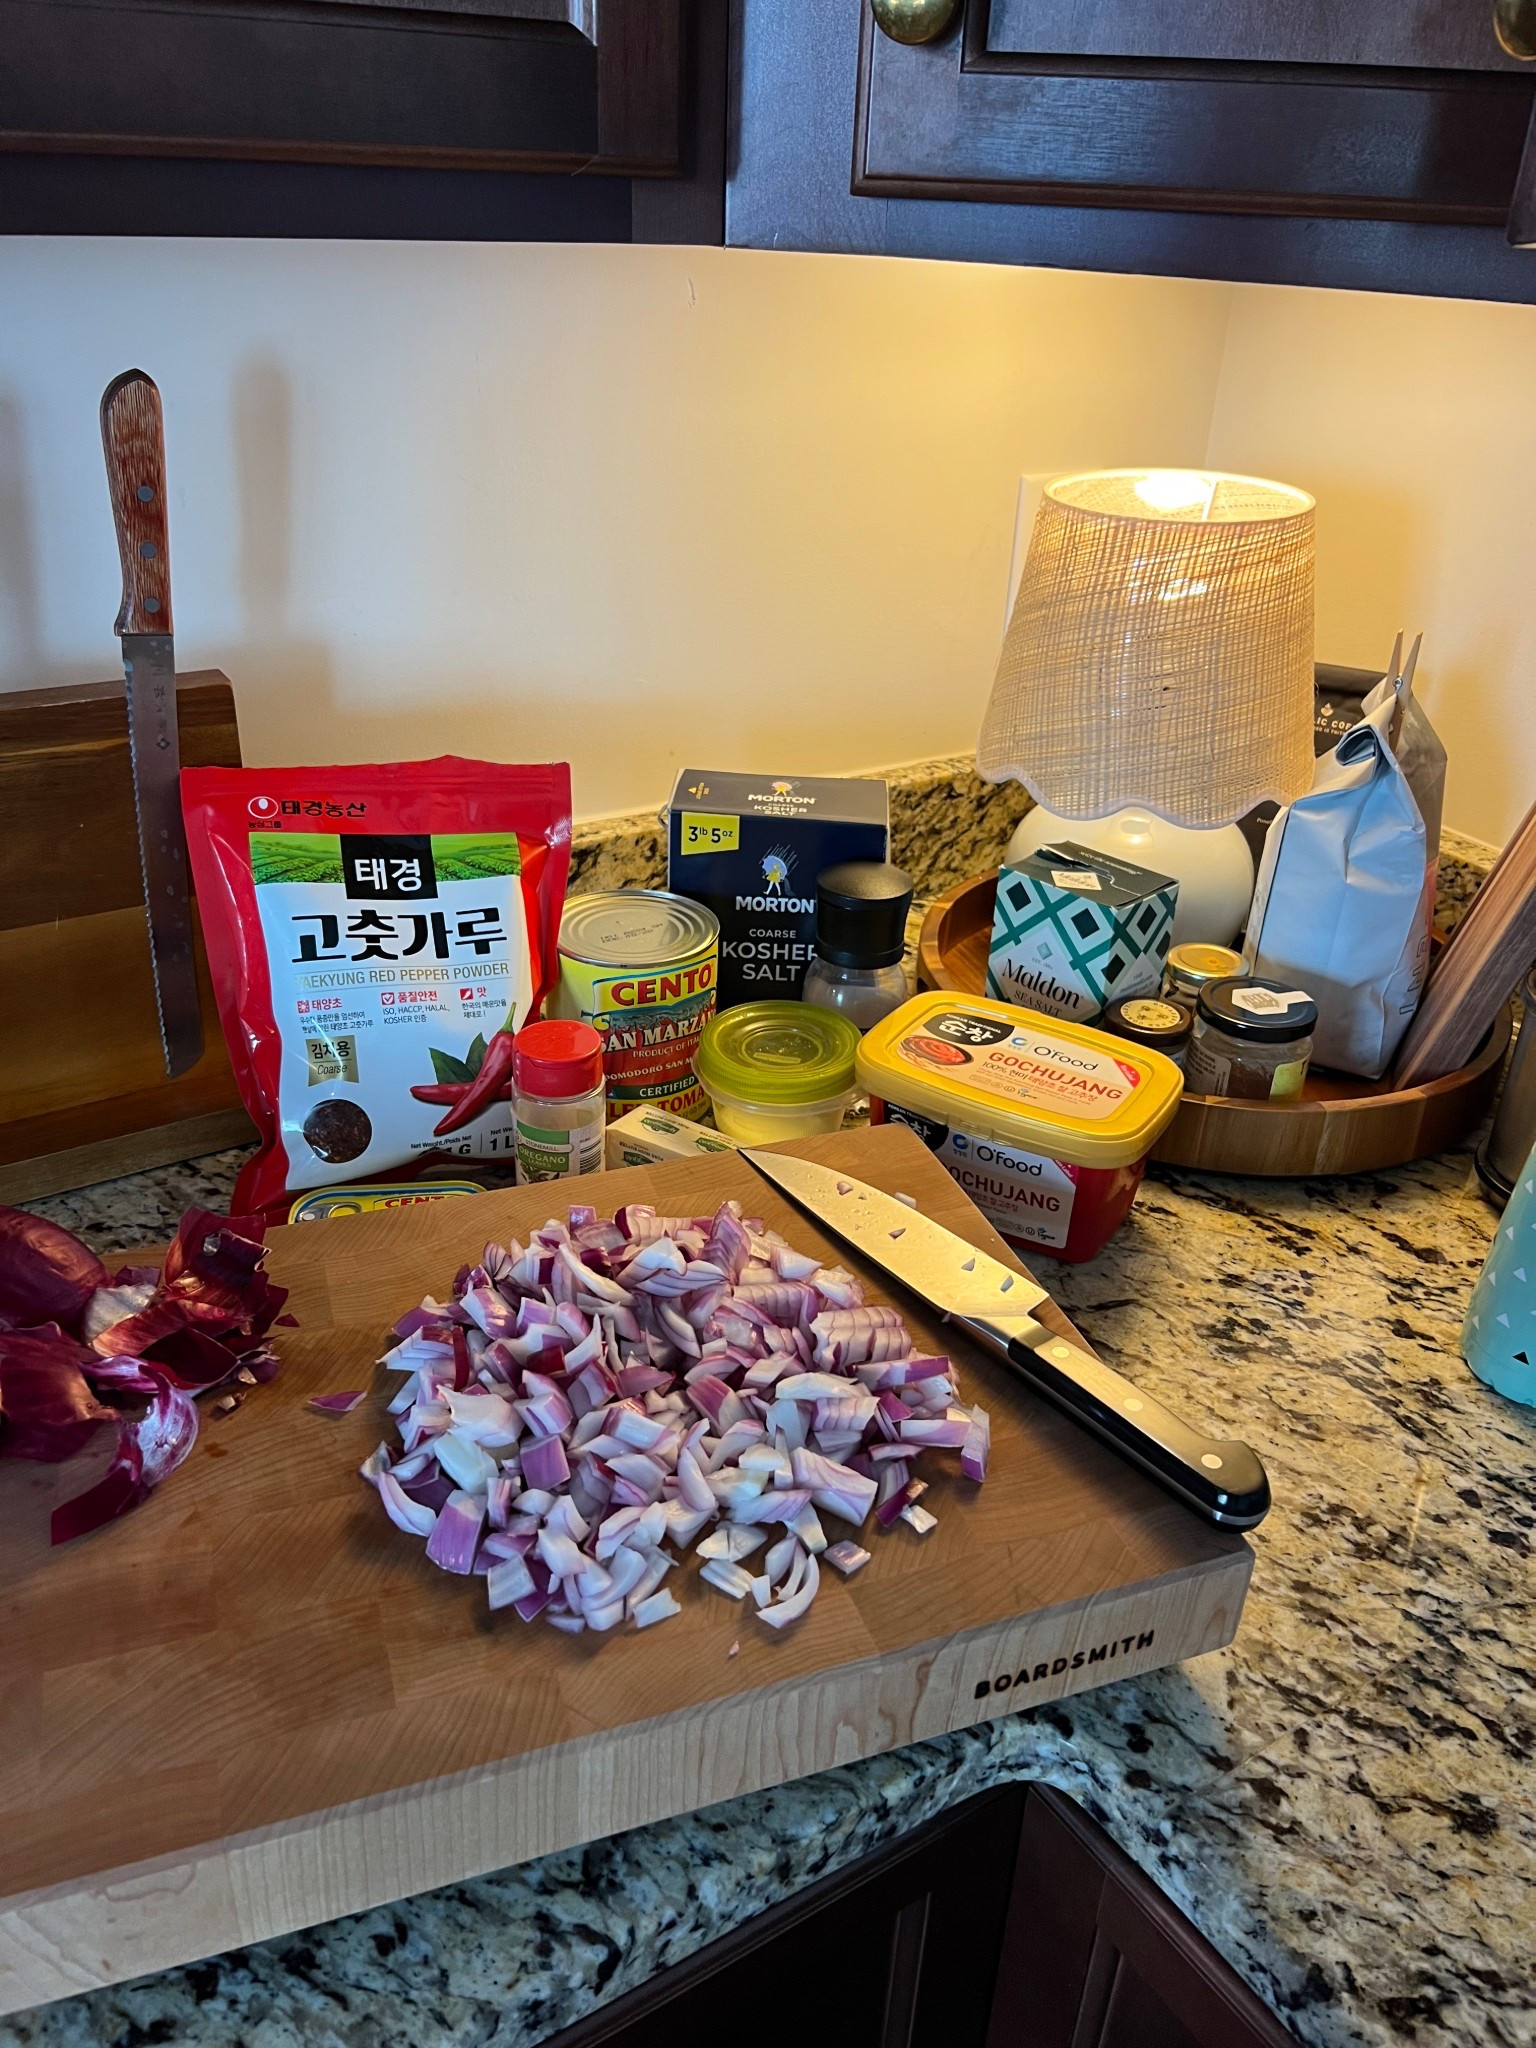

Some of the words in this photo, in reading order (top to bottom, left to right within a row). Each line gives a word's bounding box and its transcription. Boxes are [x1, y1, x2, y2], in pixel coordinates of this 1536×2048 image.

[747, 794, 816, 804] MORTON
[281, 800, 367, 818] 태경농산
[754, 805, 807, 813] KOSHER
[354, 858, 422, 892] 태경
[735, 896, 815, 914] MORTON
[291, 907, 508, 963] 고춧가루
[749, 929, 797, 938] COARSE
[298, 970, 365, 989] AEKYUNG
[369, 969, 396, 983] RED
[400, 966, 450, 981] PEPPER
[454, 962, 510, 980] POWDER
[742, 963, 801, 981] SALT
[477, 986, 487, 998] 맛
[611, 963, 712, 1006] CENTO
[1002, 958, 1080, 1010] Maldon
[312, 998, 342, 1010] 태양초
[398, 990, 438, 1003] 품질안전
[1014, 989, 1035, 1007] SEA
[1035, 1000, 1063, 1017] SALT
[383, 1007, 397, 1016] ISO,
[398, 1005, 425, 1014] HACCP,
[425, 1004, 450, 1012] HALAL,
[462, 1002, 481, 1010] 한국의
[331, 1022, 349, 1031] 태양초
[350, 1020, 374, 1029] 고춧가루
[384, 1016, 412, 1024] KOSHER
[414, 1015, 427, 1023] 인증
[939, 1020, 993, 1042] 순창
[311, 1041, 350, 1059] 김치용
[633, 1047, 674, 1058] PRODUCT
[676, 1043, 686, 1051] OF
[688, 1037, 700, 1048] ITAL
[317, 1064, 348, 1075] Coarse
[665, 1059, 684, 1069] SAN
[982, 1061, 1007, 1073] 100%
[1009, 1069, 1028, 1080] 현미
[988, 1052, 1123, 1099] GOCHUJANG
[639, 1076, 695, 1097] CERTIFIED
[490, 1128, 501, 1136] Net
[410, 1142, 422, 1150] Net
[490, 1138, 497, 1151] 1
[505, 1135, 514, 1149] L
[519, 1145, 566, 1164] OREGANO
[976, 1146, 1042, 1176] O'Food
[947, 1165, 1060, 1212] OCHUJANG
[974, 1629, 1155, 1700] BOARDSMITH
